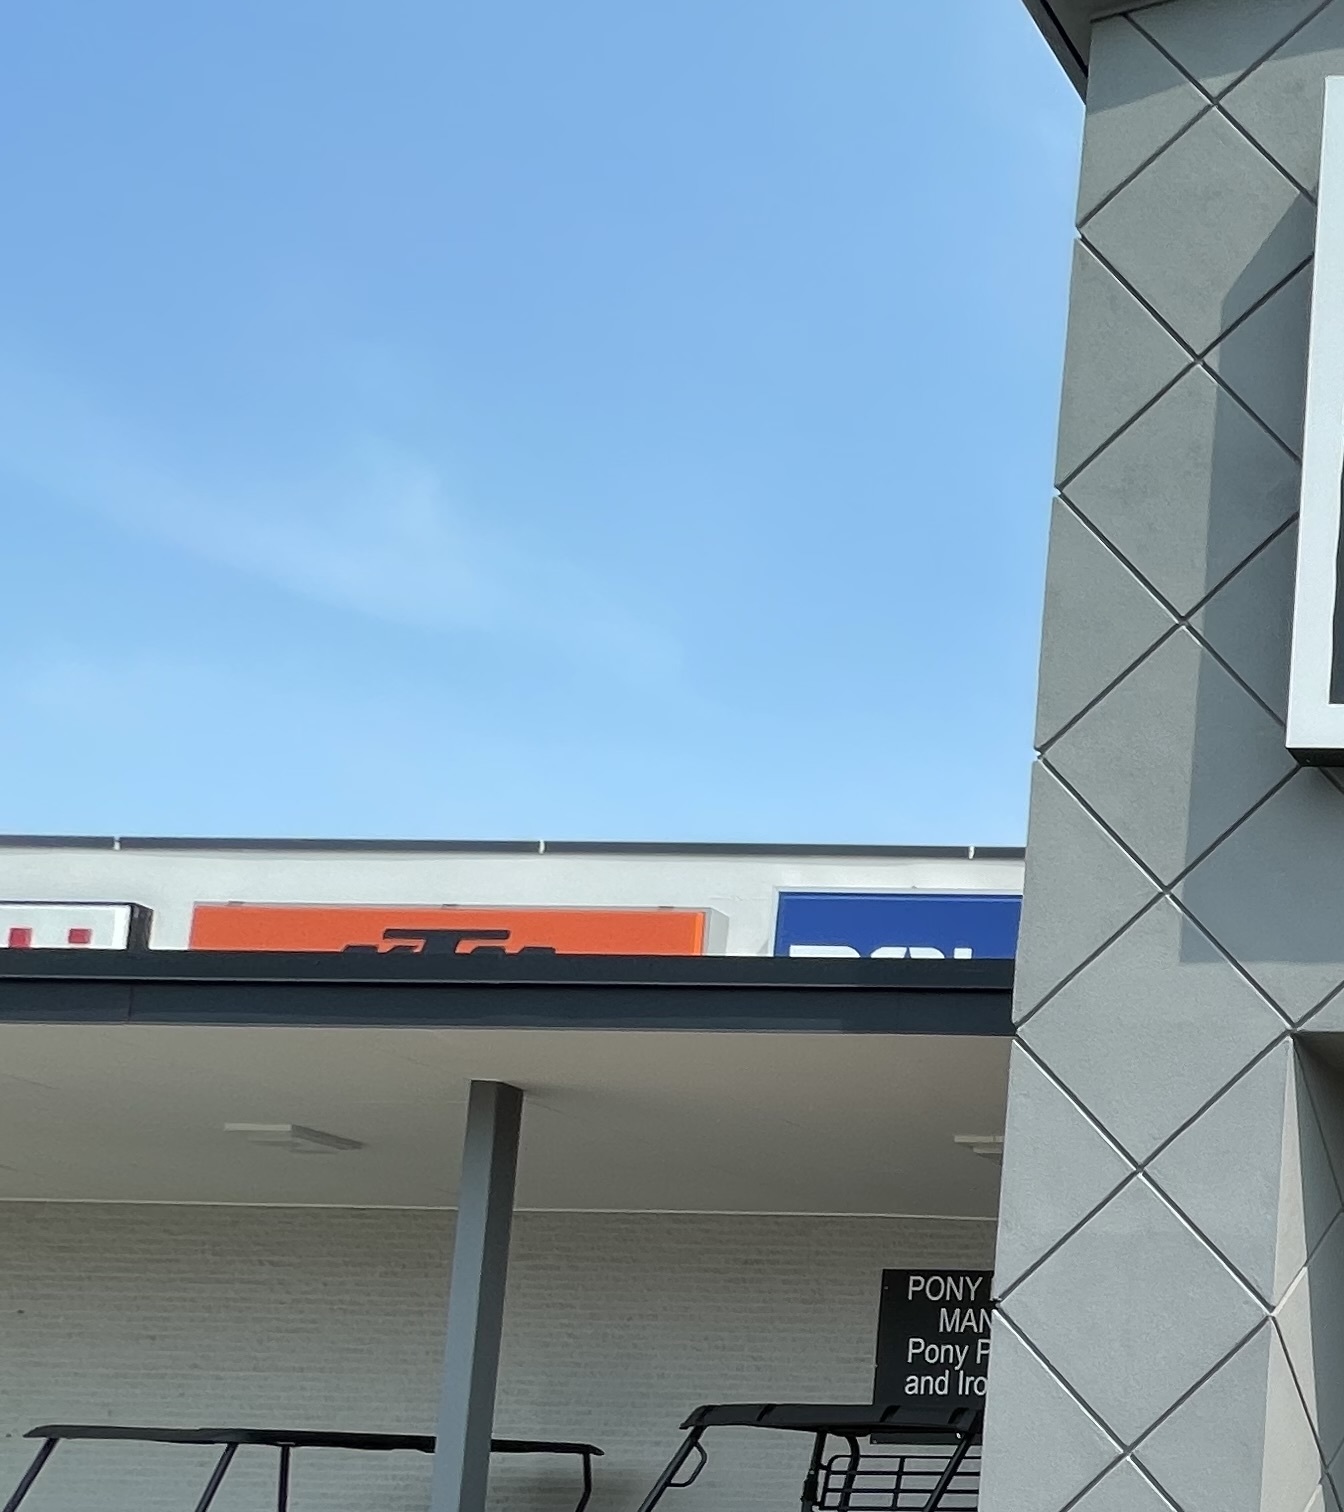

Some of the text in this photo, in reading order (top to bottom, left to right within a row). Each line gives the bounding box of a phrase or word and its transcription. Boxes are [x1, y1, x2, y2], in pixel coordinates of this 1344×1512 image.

[908, 1275, 984, 1301] PONY
[907, 1337, 970, 1371] Pony
[904, 1369, 949, 1395] and
